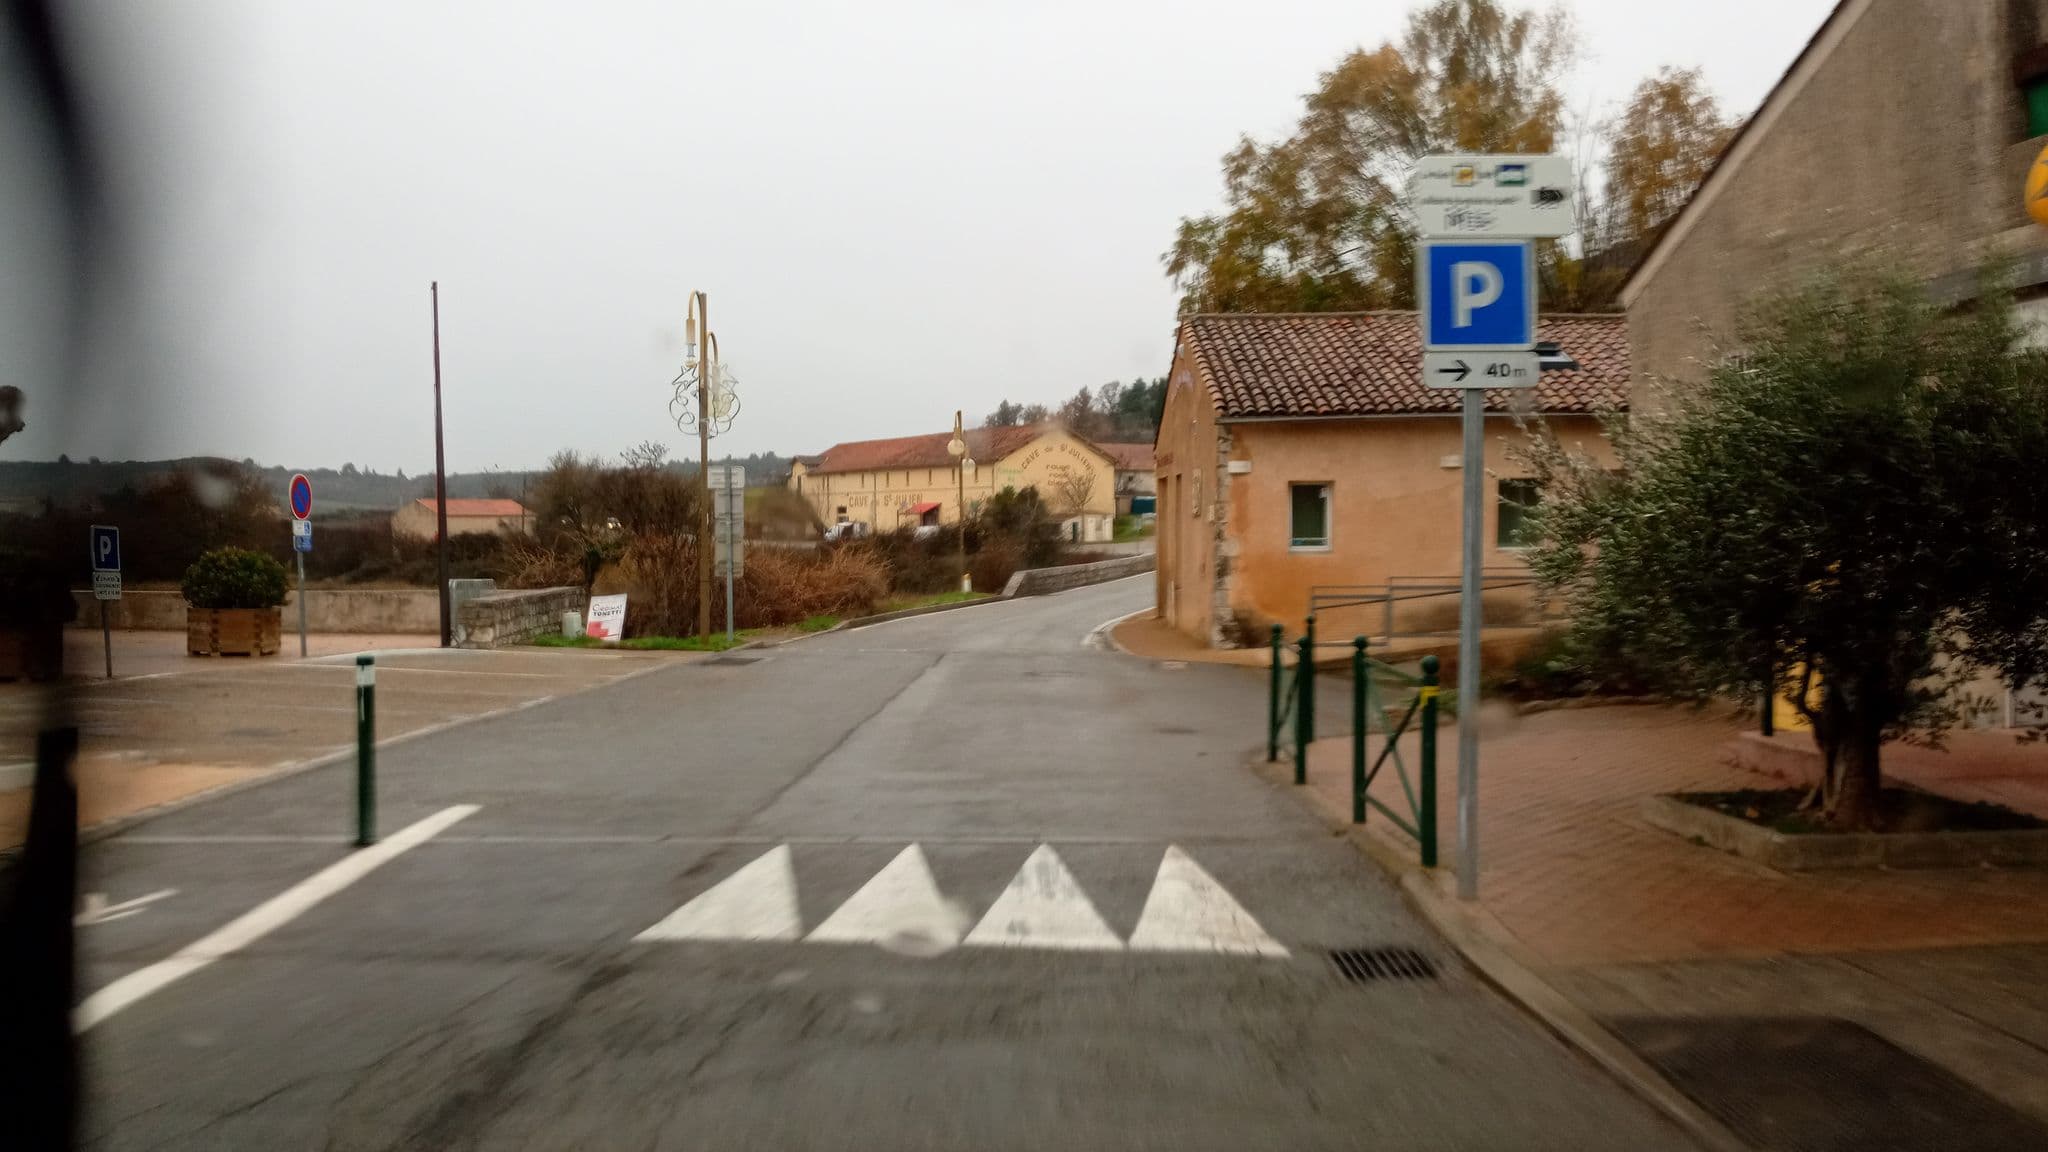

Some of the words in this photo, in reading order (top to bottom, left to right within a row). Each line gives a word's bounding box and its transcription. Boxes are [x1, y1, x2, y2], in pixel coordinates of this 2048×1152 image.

[1450, 261, 1504, 328] P
[1021, 448, 1041, 469] CAVE
[849, 496, 868, 507] CAVE
[100, 535, 112, 561] P
